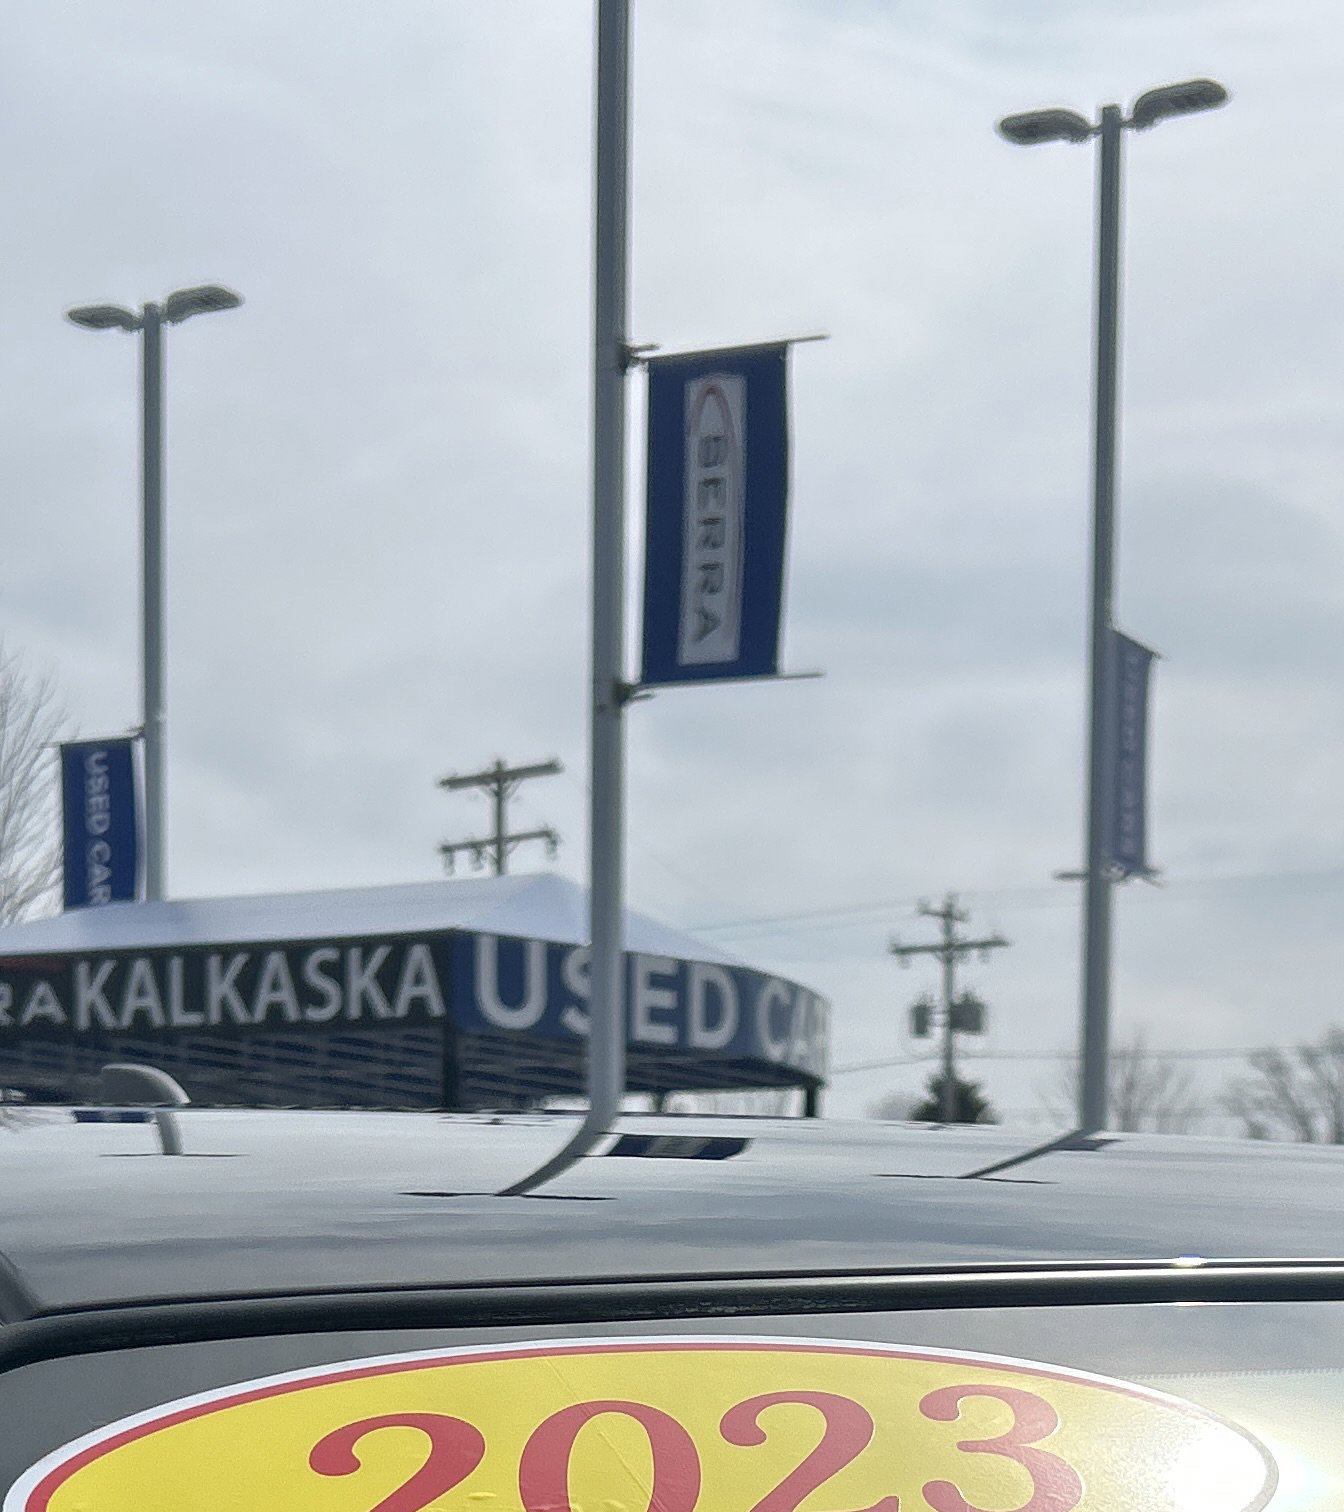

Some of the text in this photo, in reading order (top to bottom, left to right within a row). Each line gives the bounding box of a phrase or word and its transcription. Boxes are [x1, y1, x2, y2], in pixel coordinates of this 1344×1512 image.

[696, 434, 728, 645] SERRA
[84, 751, 111, 836] USED
[72, 942, 448, 1033] KALKASKA
